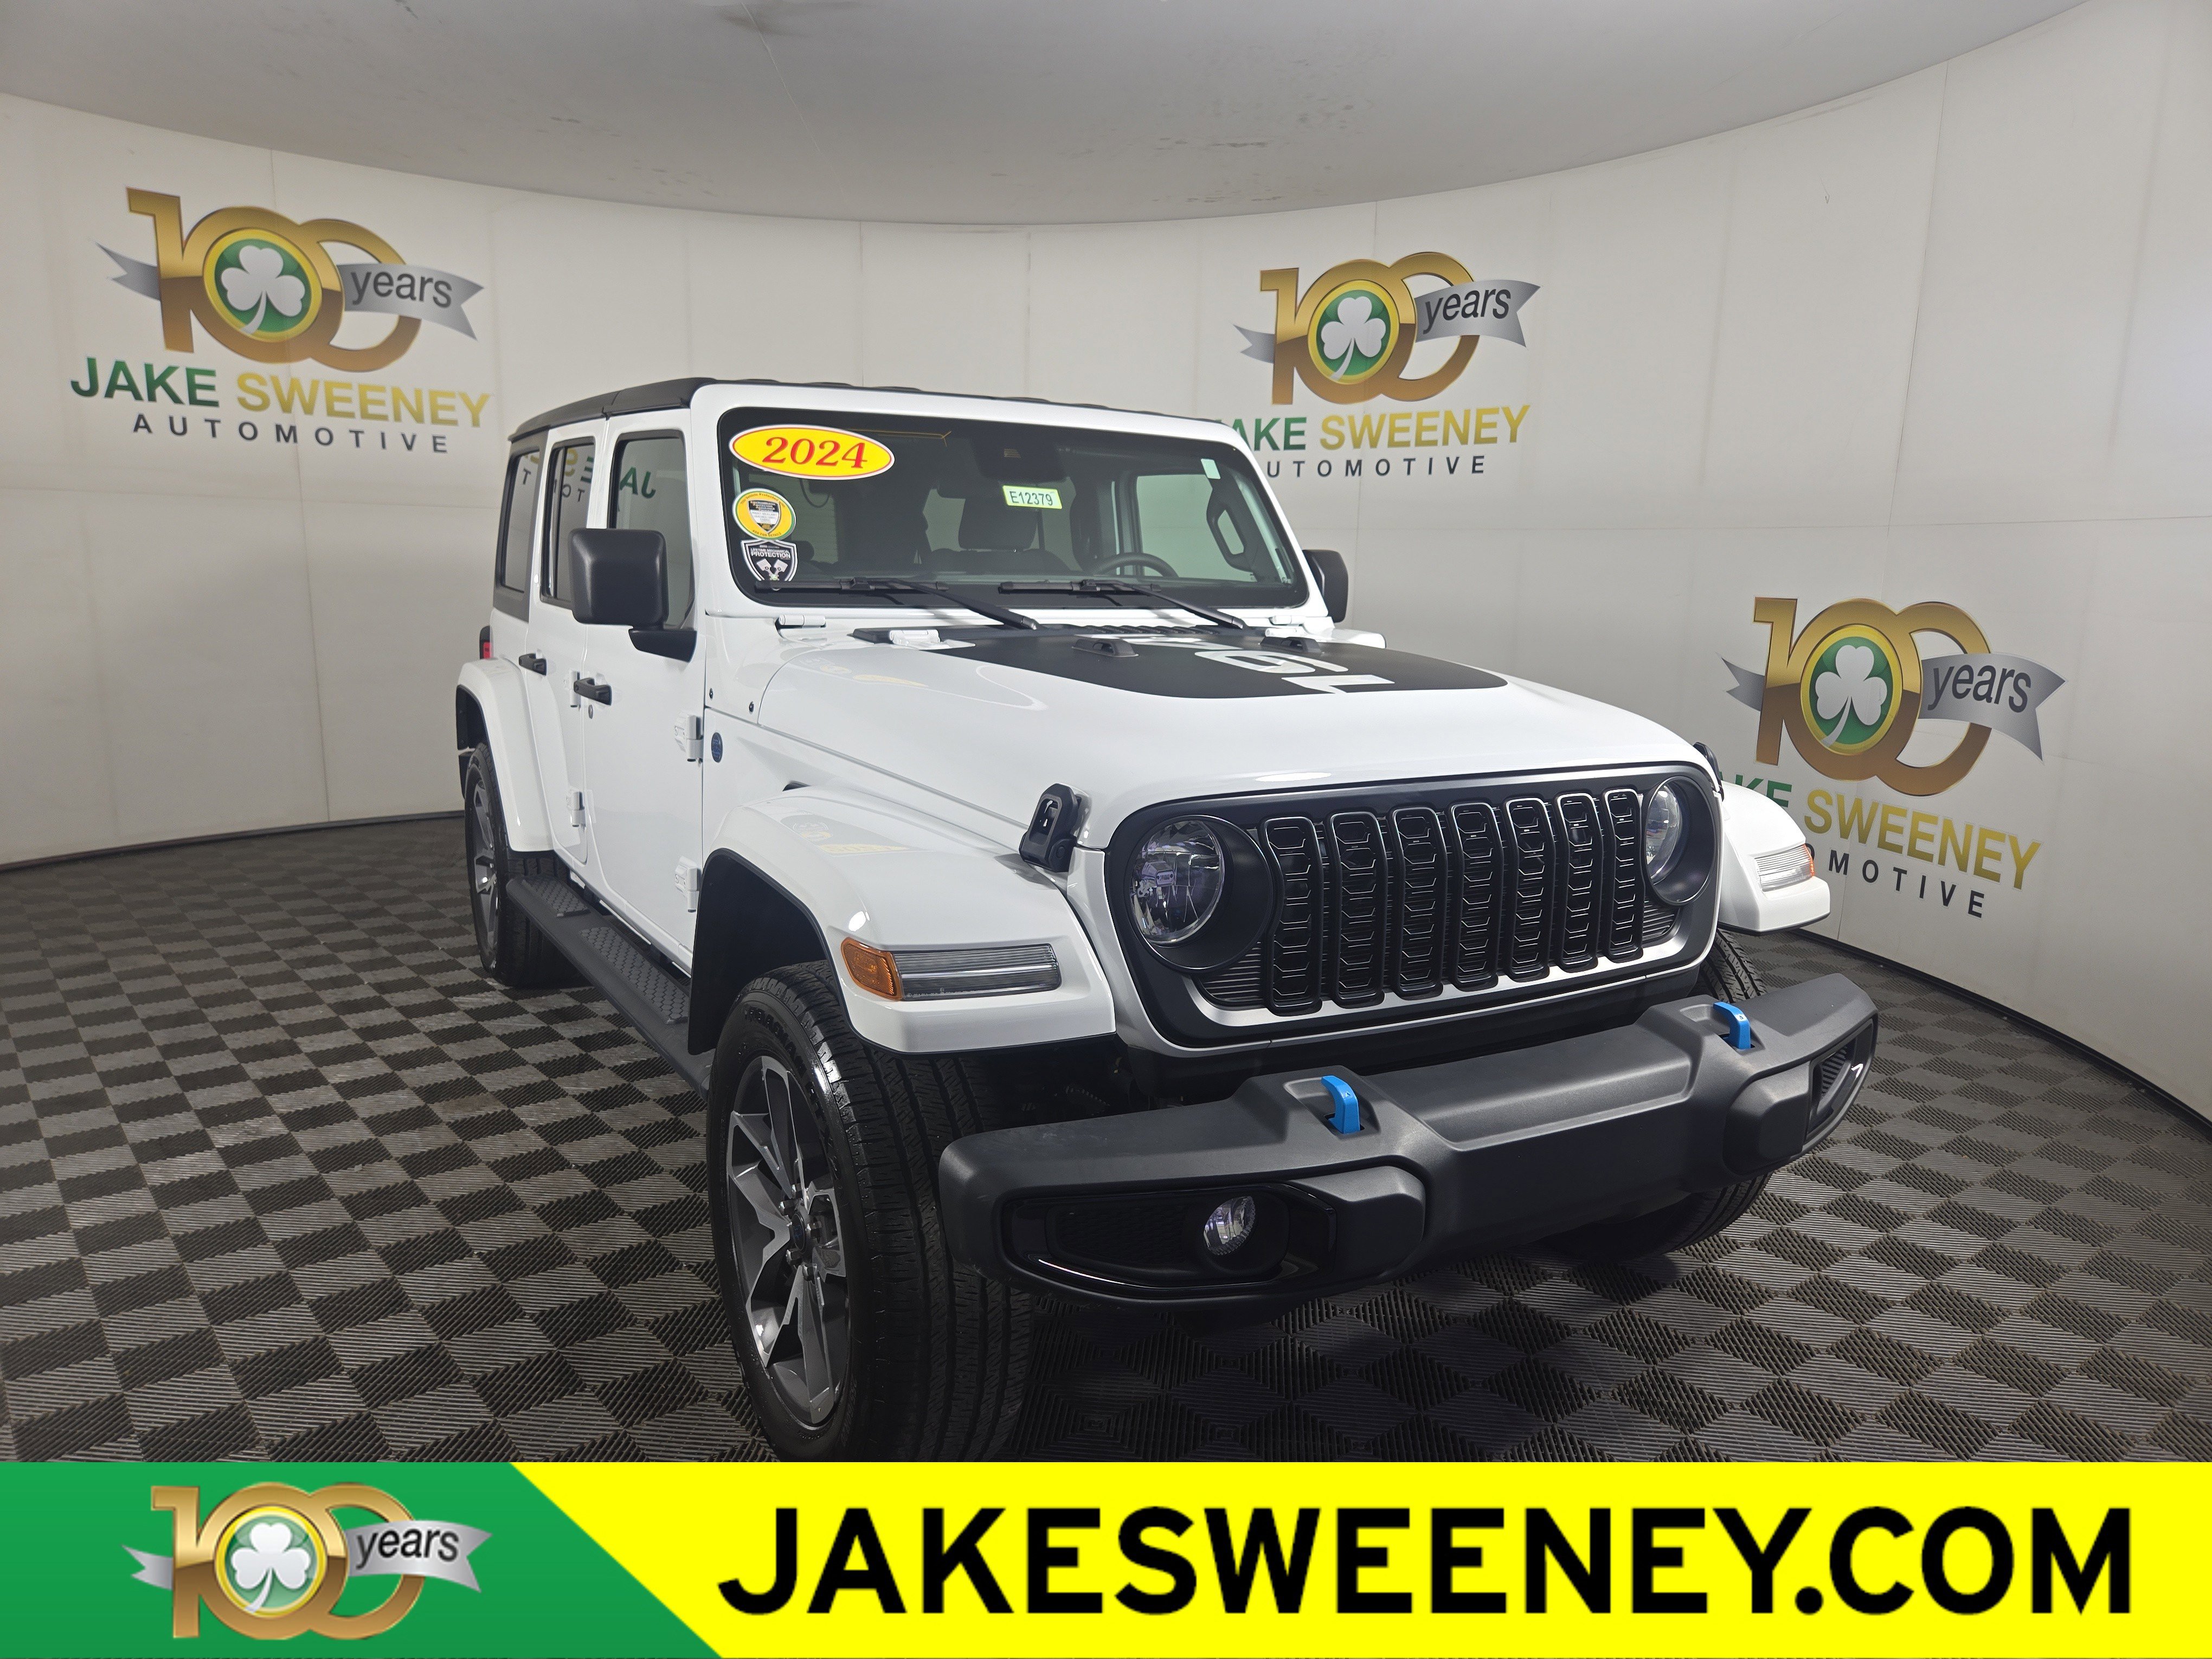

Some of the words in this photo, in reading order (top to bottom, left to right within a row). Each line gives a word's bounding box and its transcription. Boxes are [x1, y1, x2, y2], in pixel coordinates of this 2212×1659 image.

[126, 188, 421, 372] 100
[350, 268, 453, 308] years
[1261, 252, 1480, 405] 100
[1423, 288, 1511, 335] years
[70, 356, 219, 408] JAKE
[237, 372, 490, 428] SWEENEY
[133, 413, 448, 453] AUTOMOTIVE
[1217, 416, 1307, 451] AKE
[1320, 405, 1530, 450] SWEENEY
[762, 436, 867, 468] 2024
[1266, 455, 1485, 478] UTOMOTIVE
[1009, 491, 1053, 506] E12379
[1753, 597, 1992, 796] 100
[1927, 664, 2031, 713] years
[1804, 789, 2041, 891] SWEENEY
